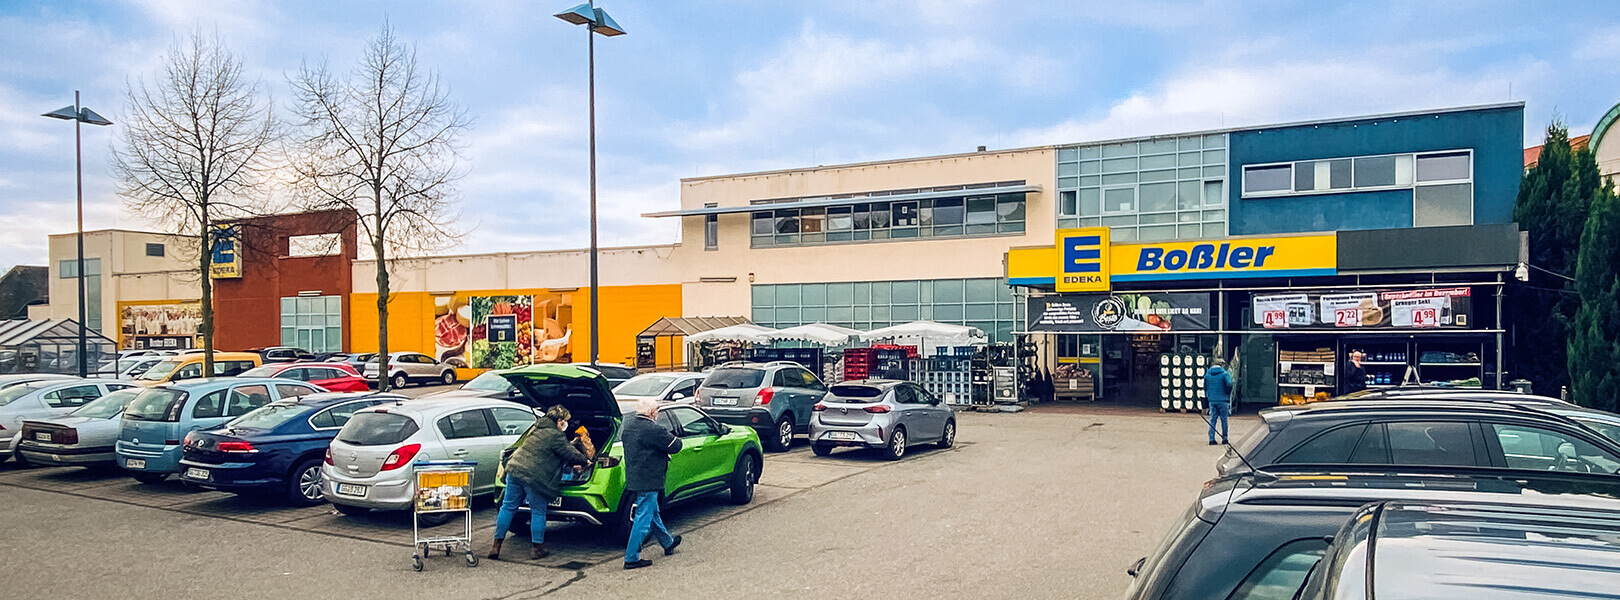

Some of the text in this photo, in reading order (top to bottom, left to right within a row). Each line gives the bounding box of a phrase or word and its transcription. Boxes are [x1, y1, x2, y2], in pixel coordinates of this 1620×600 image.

[1063, 235, 1101, 273] E
[1136, 243, 1275, 271] Boßler
[1063, 275, 1102, 284] EDEKA
